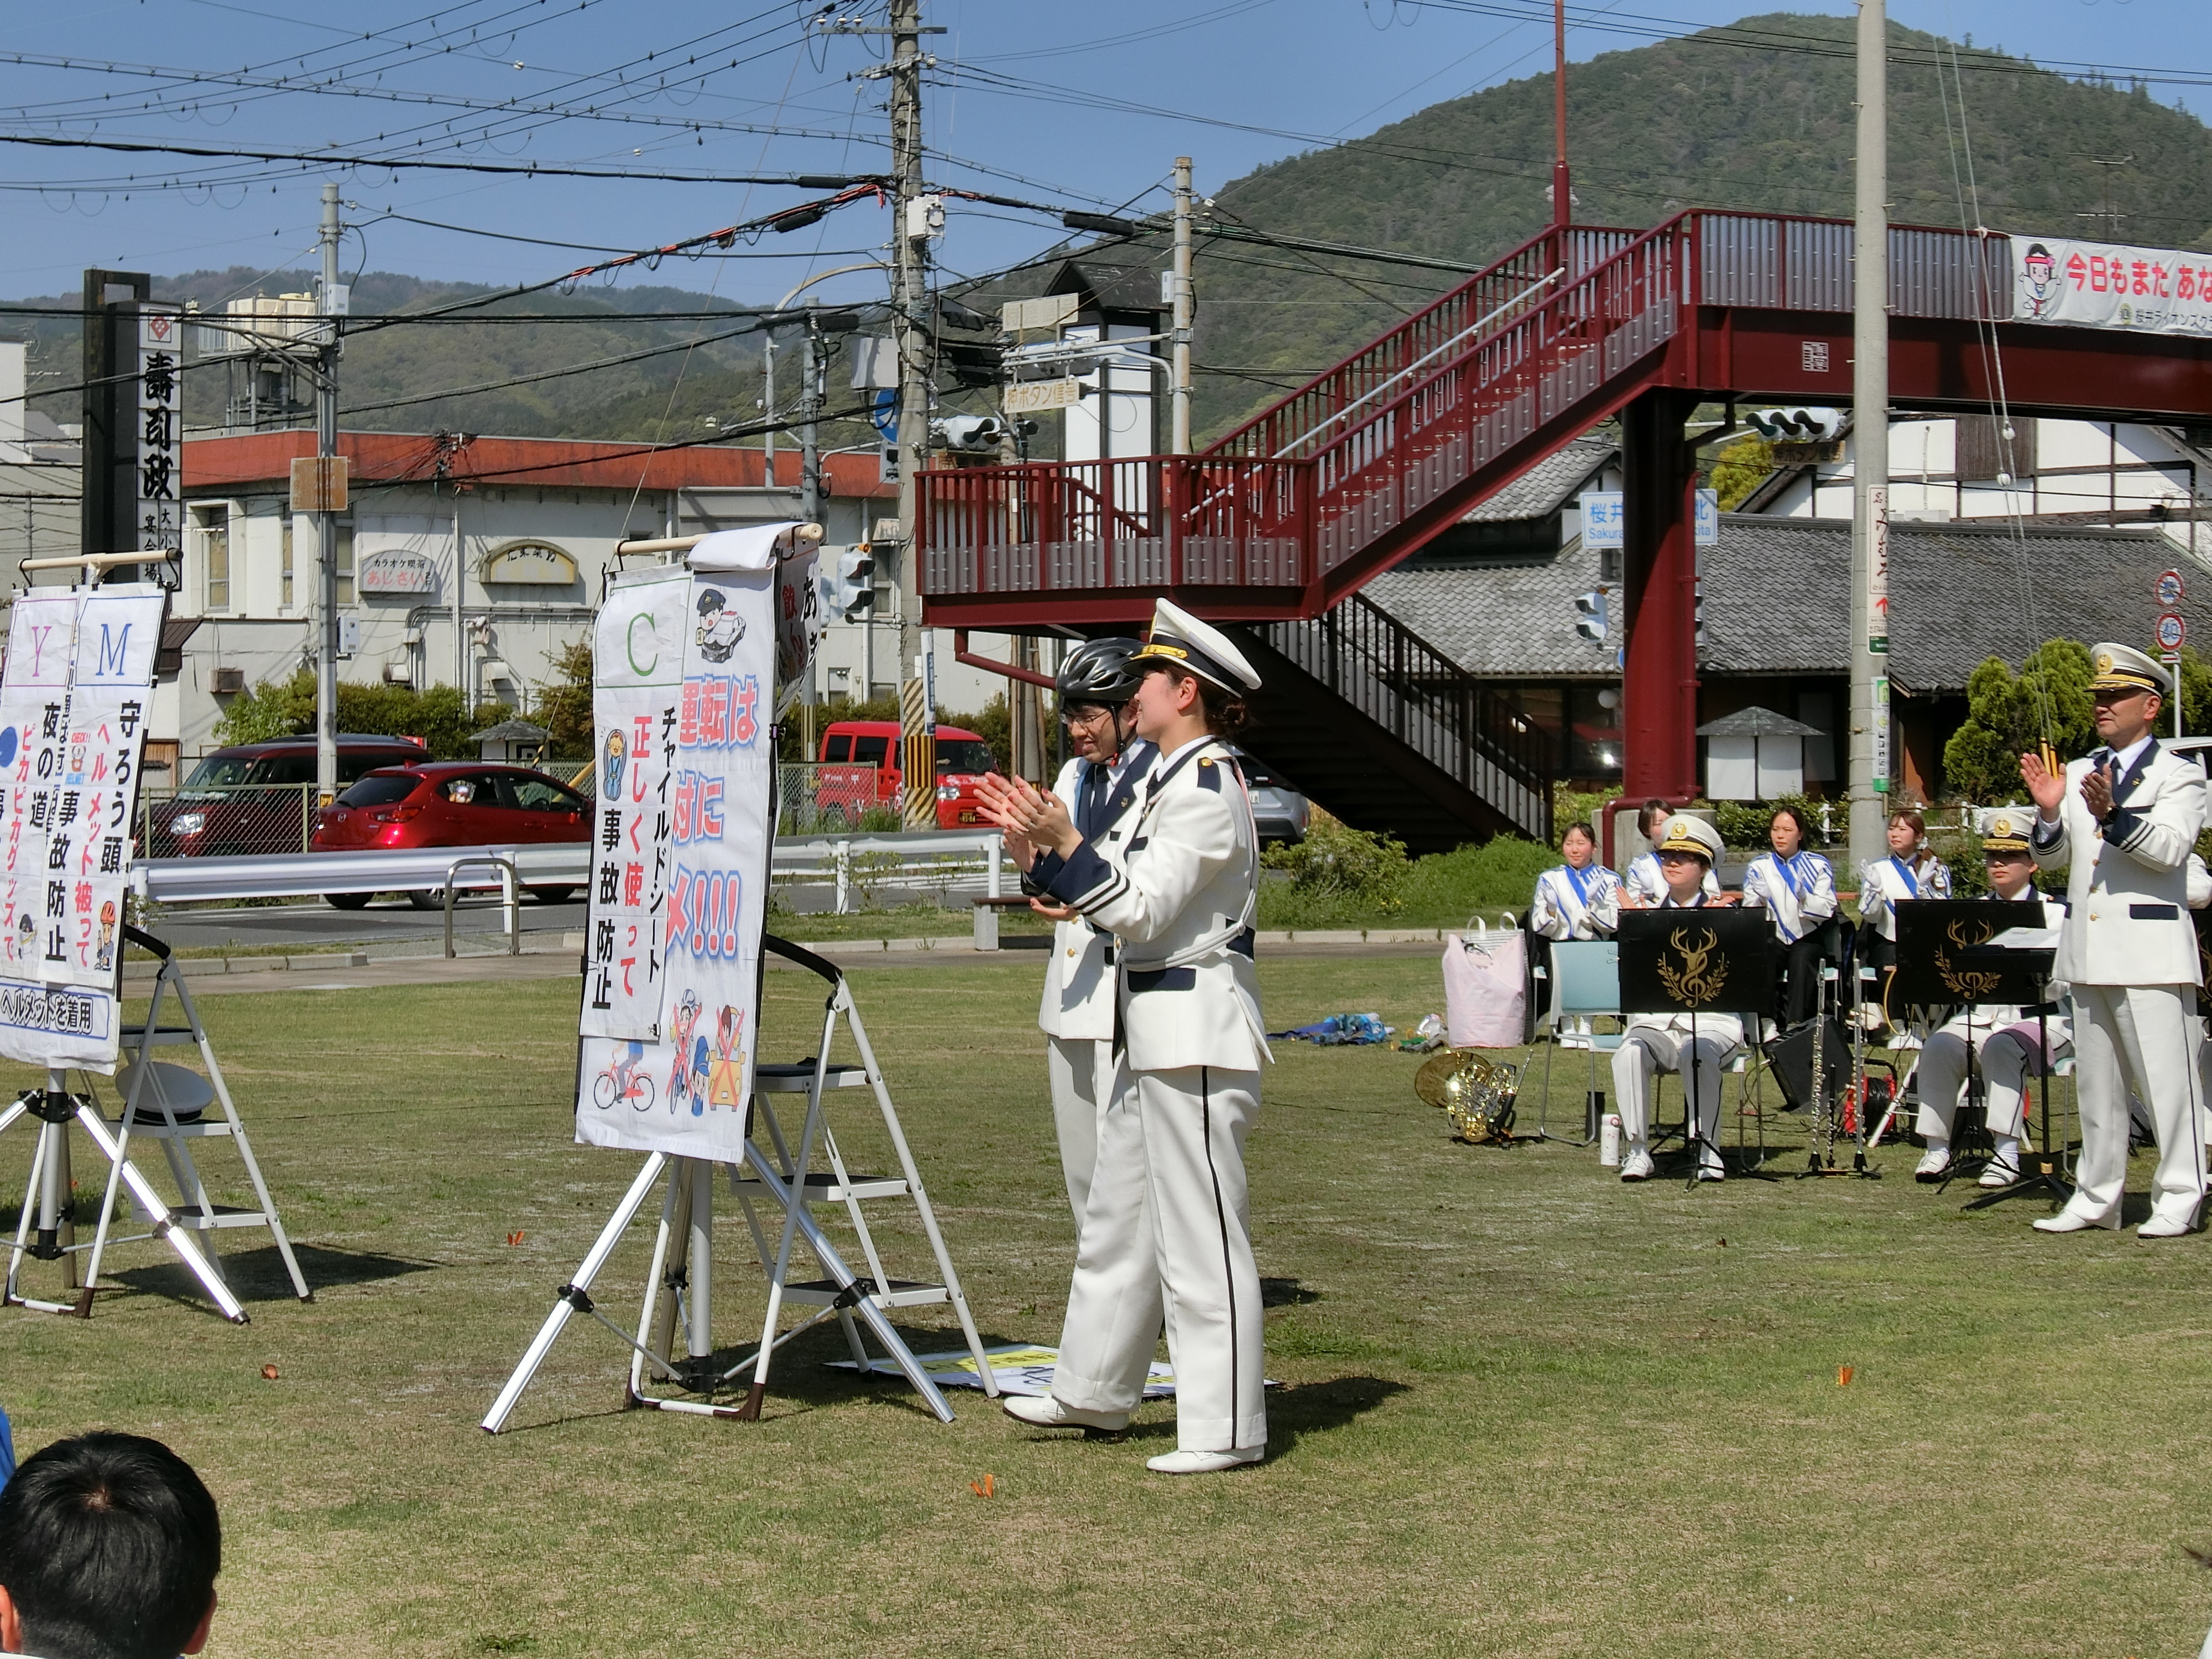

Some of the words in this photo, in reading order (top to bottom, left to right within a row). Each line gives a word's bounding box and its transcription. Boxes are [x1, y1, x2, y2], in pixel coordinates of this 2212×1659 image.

[1007, 381, 1077, 410] 押ボタン信号
[31, 625, 53, 677] Y
[95, 623, 133, 676] M
[627, 612, 659, 677] C
[2163, 623, 2179, 640] 40
[4, 723, 36, 961] ピカピカグッズで
[29, 702, 61, 828] 夜の道
[75, 723, 111, 967] ヘルメット被って
[101, 700, 142, 874] 守ろう頭
[649, 706, 677, 984] チャイルドシート
[45, 790, 81, 962] 事故防止
[592, 808, 622, 1009] 事故防止
[620, 716, 653, 998] 正しく使って
